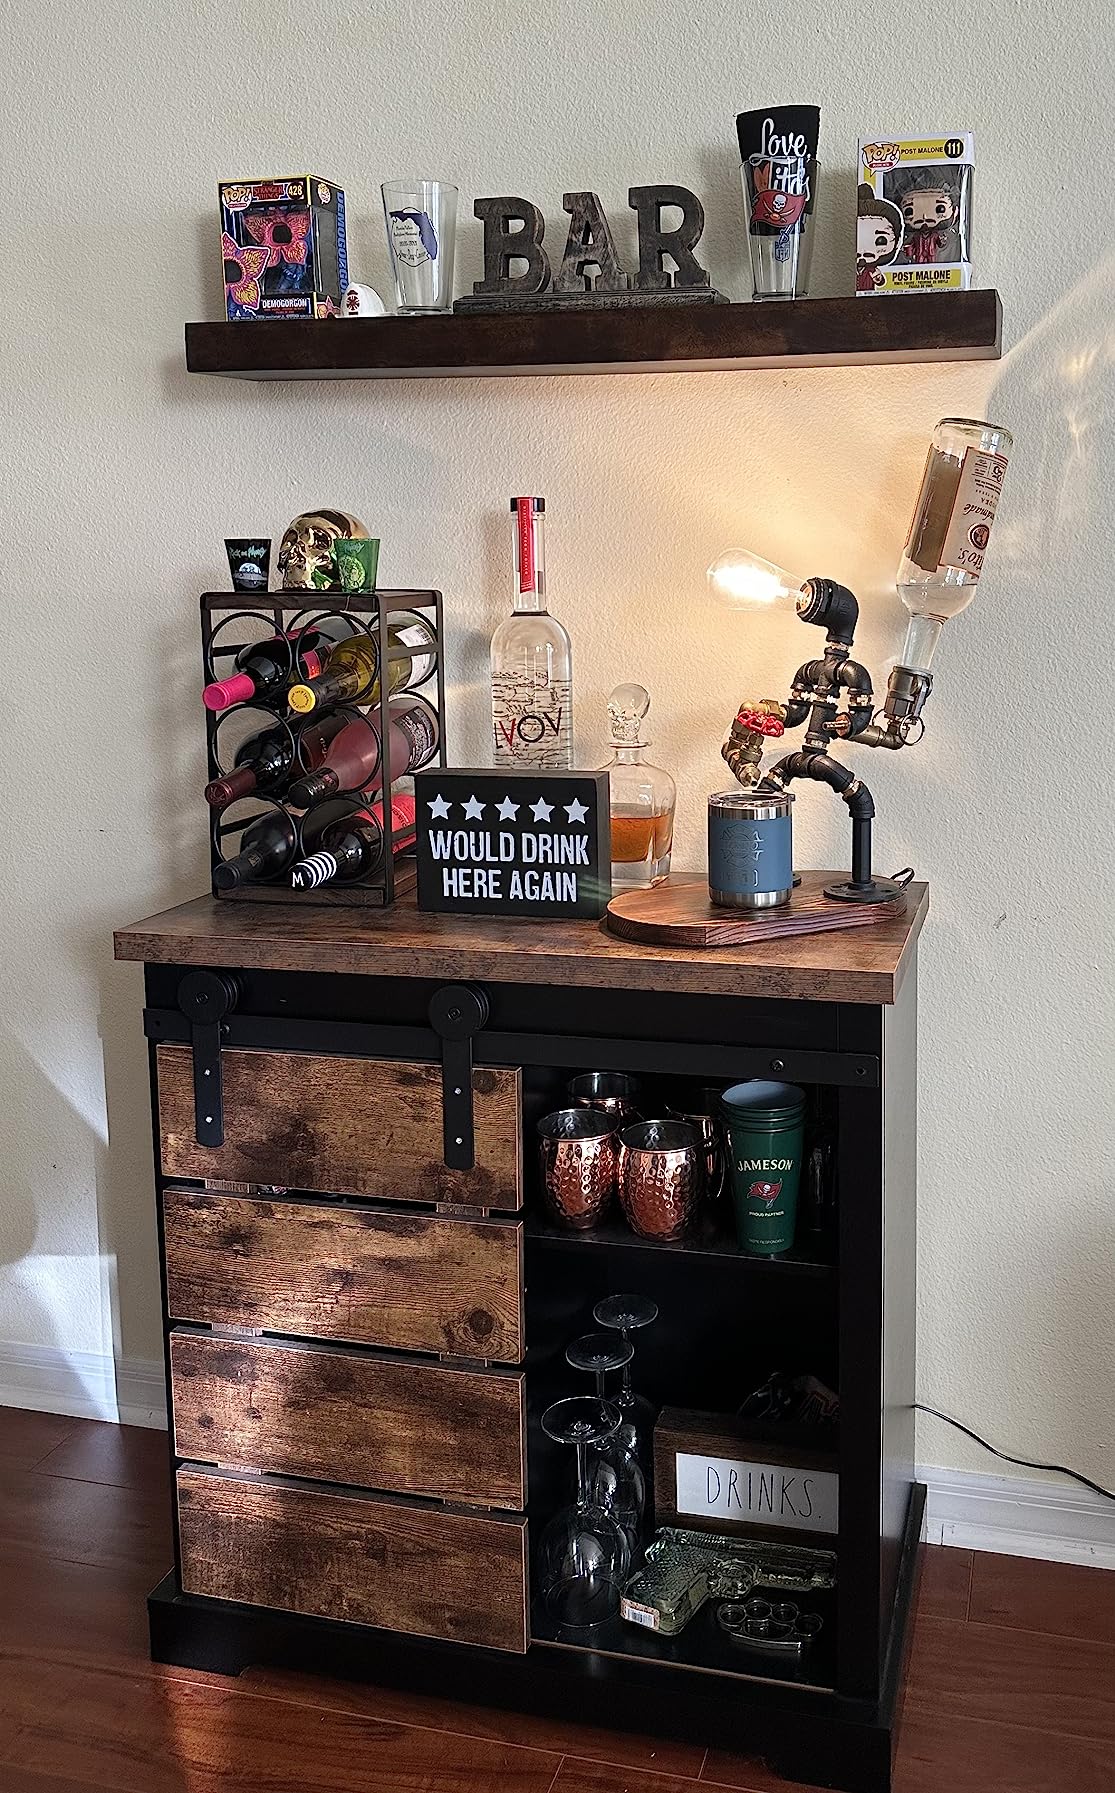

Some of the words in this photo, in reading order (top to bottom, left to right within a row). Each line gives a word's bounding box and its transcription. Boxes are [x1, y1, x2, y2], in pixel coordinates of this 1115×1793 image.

[749, 118, 811, 167] Love,
[917, 146, 944, 154] MALONE
[947, 142, 961, 155] 111
[862, 143, 900, 163] POP!
[222, 186, 252, 204] POP!
[253, 185, 283, 195] STRANGER
[288, 185, 303, 196] 428
[337, 192, 349, 293] DEMOGORGO
[473, 184, 710, 296] BAR
[892, 271, 914, 282] POST
[915, 269, 951, 281] MALONE
[262, 298, 307, 309] DEMOGORGON
[428, 829, 515, 862] WOULD
[521, 832, 590, 866] DRINK
[291, 871, 305, 888] M
[442, 867, 503, 899] HERE
[509, 870, 577, 903] AGAIN
[738, 1159, 793, 1171] JAMESON
